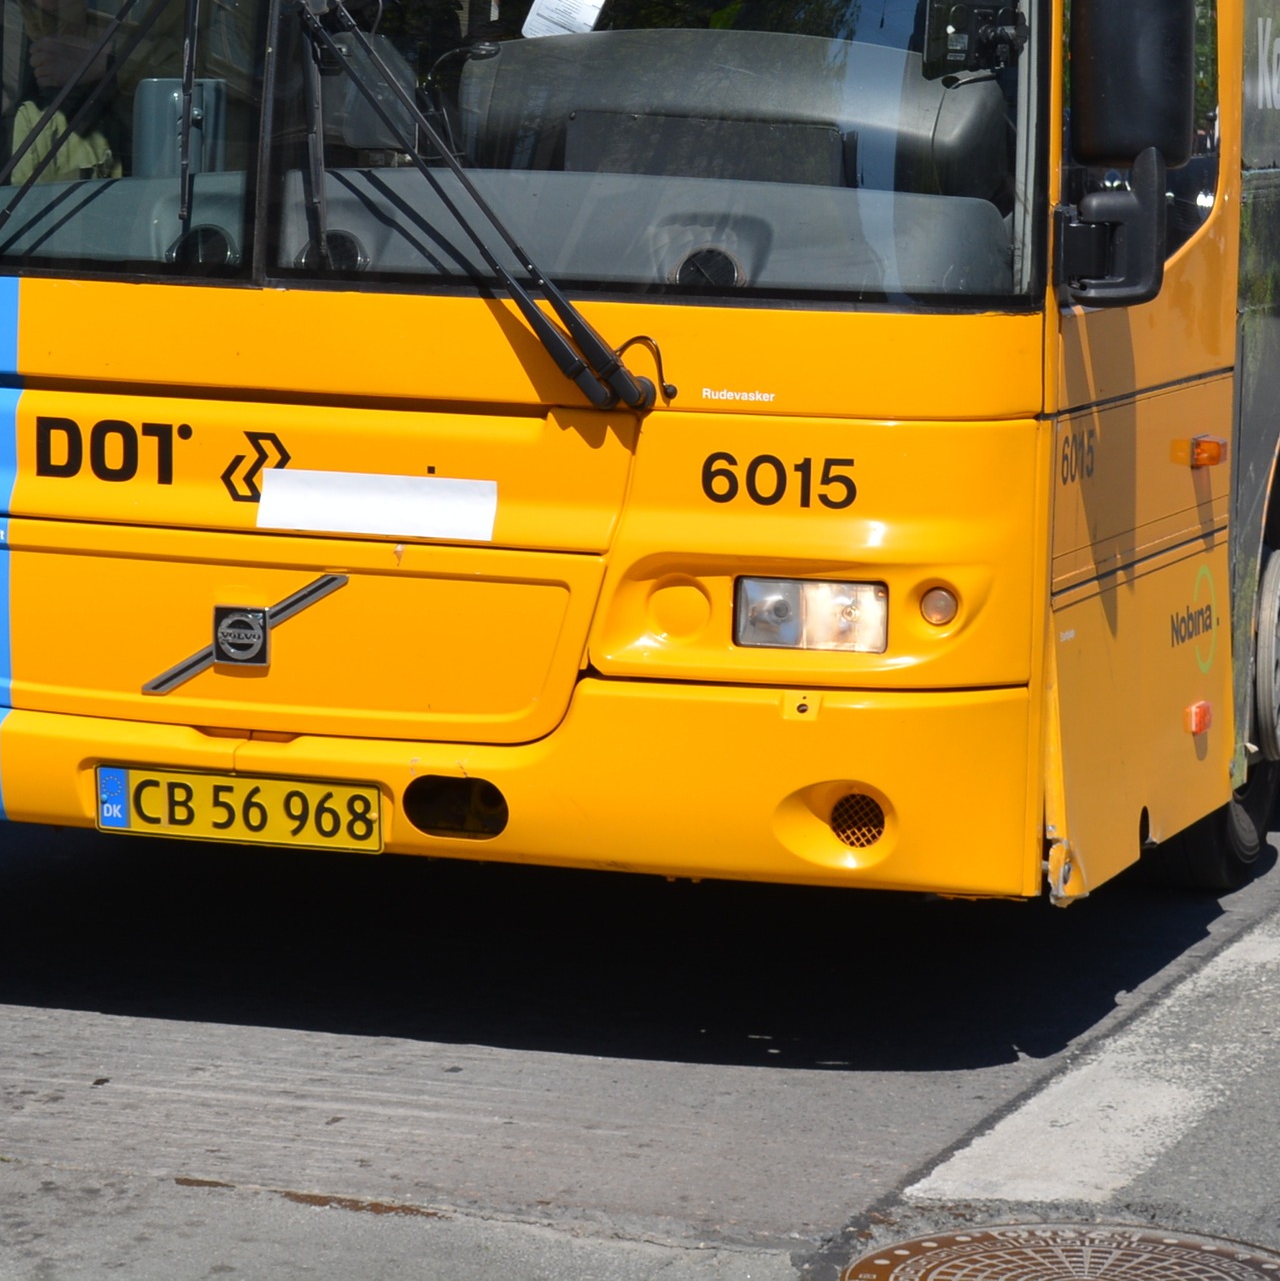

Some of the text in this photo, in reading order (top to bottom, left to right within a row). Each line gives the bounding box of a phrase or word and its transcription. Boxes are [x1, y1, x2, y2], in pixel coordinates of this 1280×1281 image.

[702, 387, 775, 402] Rudevasker
[36, 416, 178, 485] DOT
[1061, 429, 1095, 486] 6015
[701, 451, 857, 509] 6015
[220, 630, 262, 640] VOLVO
[1171, 605, 1212, 647] Nobina
[103, 779, 374, 841] DK CB 56 968
